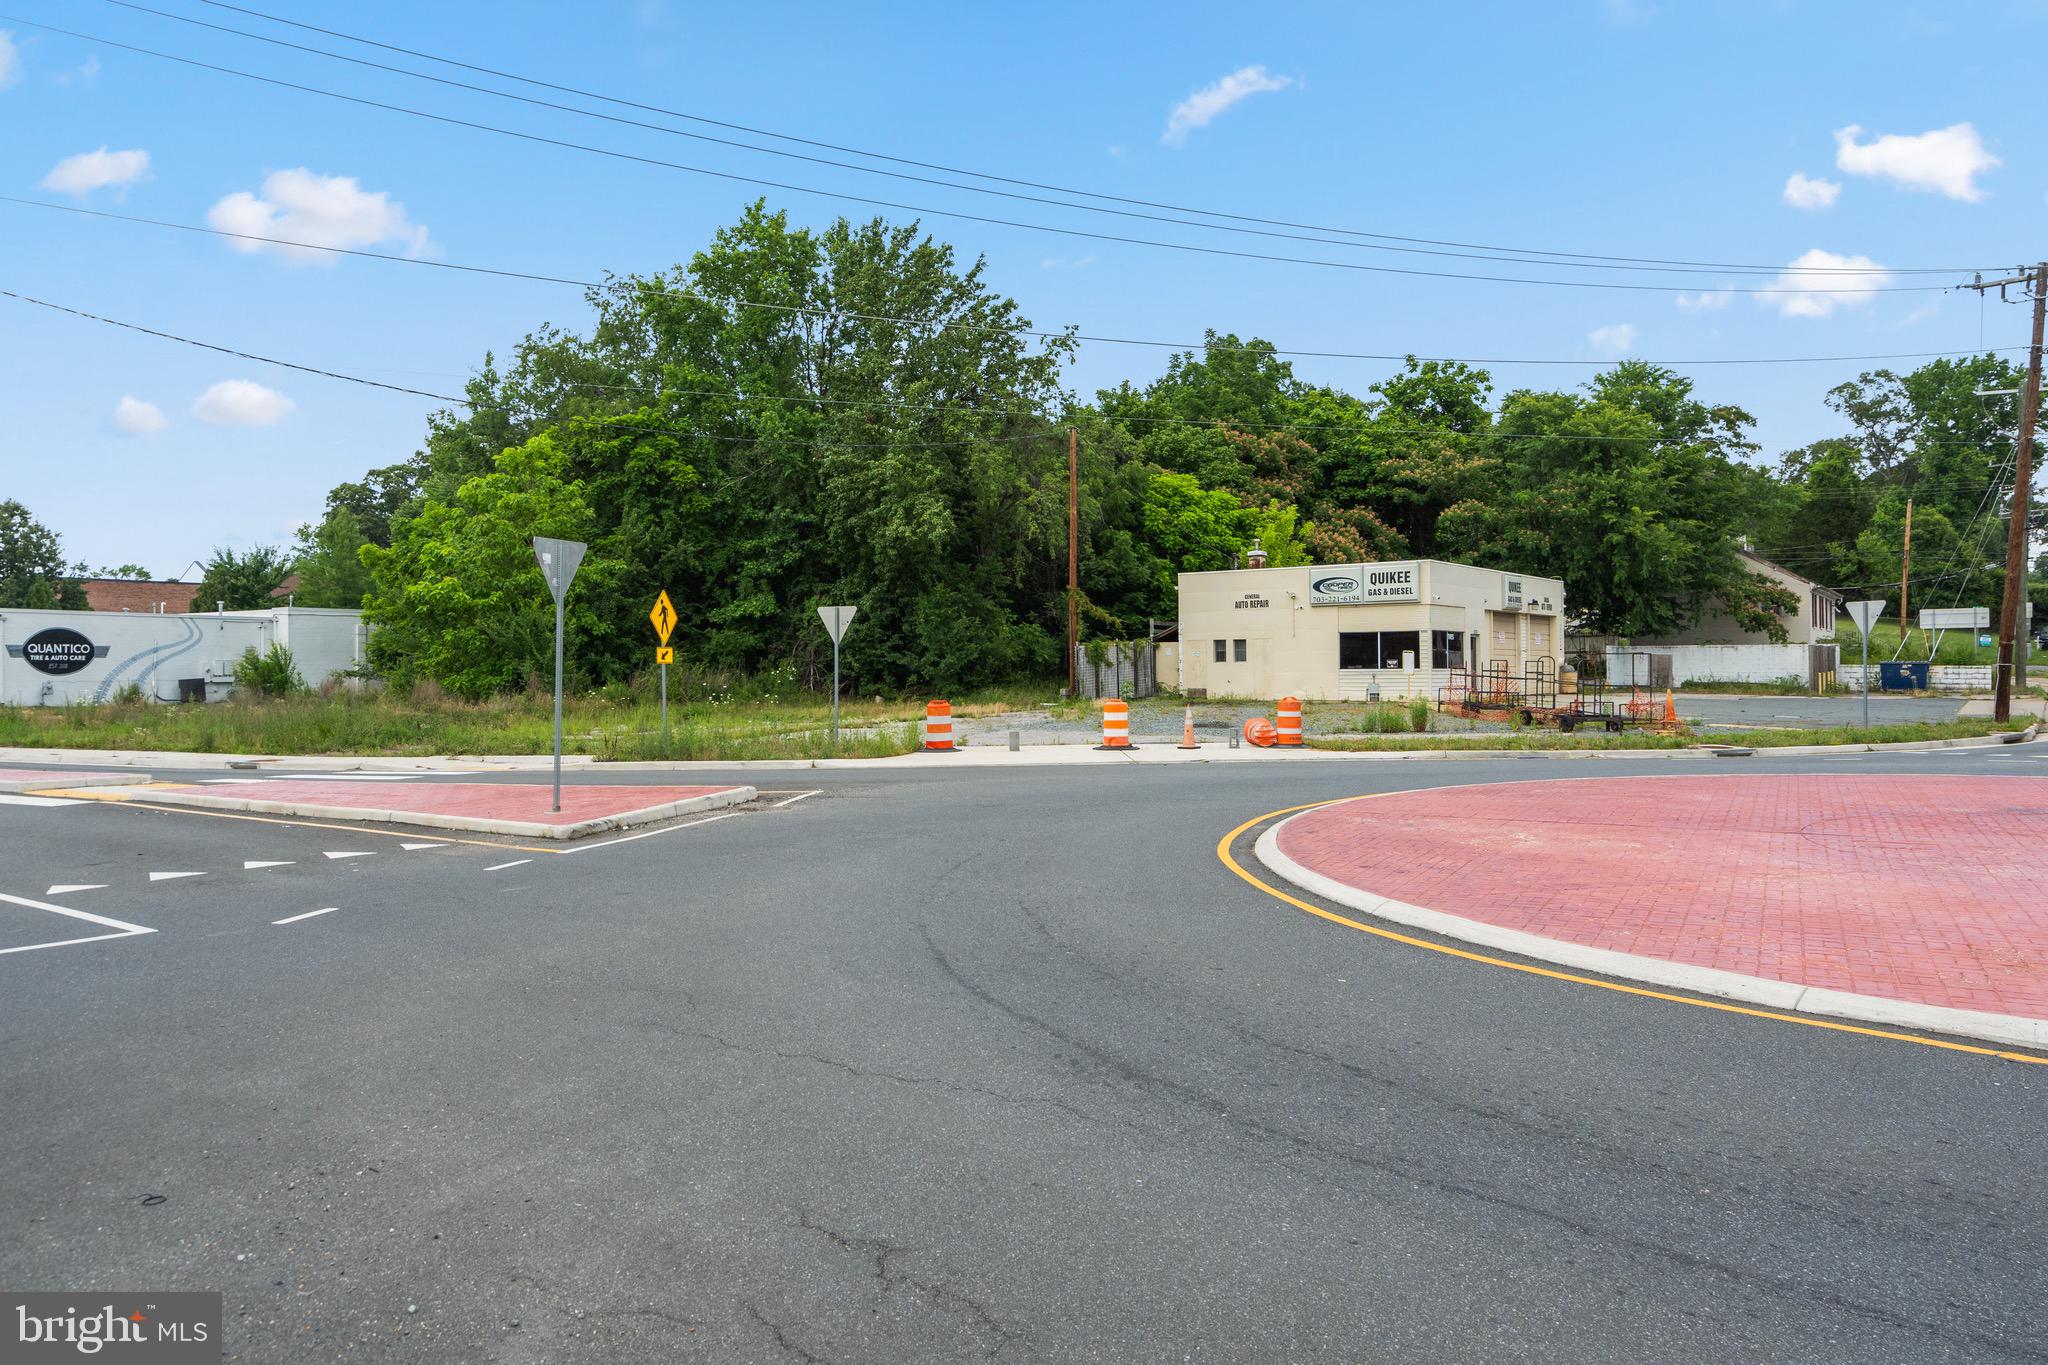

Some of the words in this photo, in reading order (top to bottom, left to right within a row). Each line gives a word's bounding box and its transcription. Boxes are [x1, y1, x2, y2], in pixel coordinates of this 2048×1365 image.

[1370, 571, 1411, 586] QUIKEE
[1368, 588, 1382, 596] GAS
[1383, 588, 1388, 596] &
[1389, 587, 1413, 596] DIESEL
[1235, 600, 1249, 609] AUTO
[1250, 599, 1269, 608] REPAIR
[1313, 595, 1360, 603] 703-221-6194
[28, 643, 90, 653] QUANTICO
